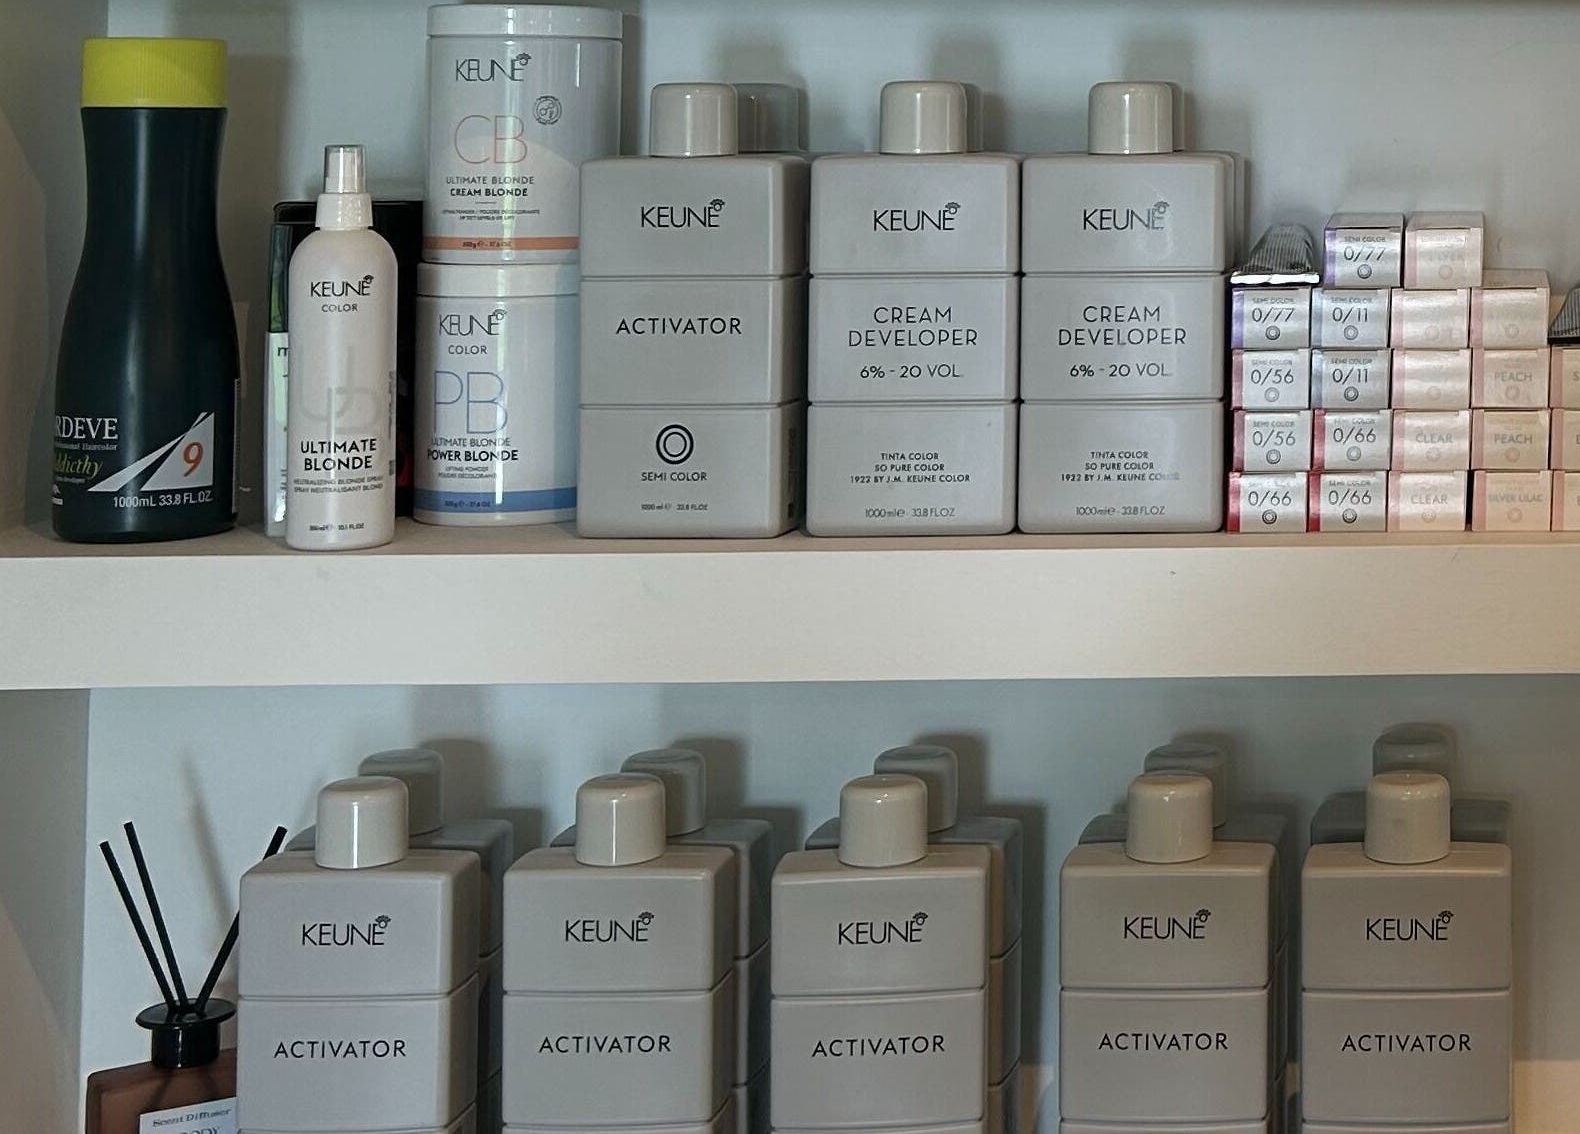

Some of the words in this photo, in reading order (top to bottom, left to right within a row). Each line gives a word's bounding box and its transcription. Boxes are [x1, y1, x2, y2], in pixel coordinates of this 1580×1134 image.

[456, 53, 532, 82] KEUNE
[455, 115, 527, 164] CB
[446, 176, 487, 185] ULTIMATE
[492, 176, 534, 185] BLONDE
[450, 188, 481, 197] CREAM
[485, 188, 528, 197] BLONDE
[640, 199, 725, 227] KEUNE
[873, 202, 961, 231] KEUNE
[1343, 246, 1384, 262] 0/77
[311, 275, 374, 297] KEUNE
[322, 304, 358, 313] COLOR
[874, 307, 952, 324] CREAM
[440, 309, 507, 336] KEUNE
[616, 318, 741, 335] ACTIVATOR
[848, 329, 978, 347] DEVELOPER
[448, 345, 487, 355] COLOR
[860, 365, 885, 378] 6%
[900, 365, 921, 378] 20
[1494, 371, 1532, 383] PEACH
[434, 370, 508, 434] PB
[301, 439, 376, 454] ULTIMATE
[431, 438, 467, 447] ULTIMATE
[470, 438, 511, 447] BLONDE
[183, 442, 203, 477] 9
[304, 455, 372, 471] BLONDE
[428, 449, 461, 461] POWER
[464, 450, 519, 461] BLONDE
[641, 472, 666, 481] SEMI
[671, 472, 707, 481] COLOR
[875, 464, 887, 472] SO
[907, 475, 936, 483] KEUNE
[939, 474, 970, 482] COLOR
[114, 496, 156, 508] 1000mL
[159, 495, 181, 506] 33.8
[301, 915, 391, 947] KEUNE
[837, 912, 928, 947] KEUNE
[1365, 911, 1453, 943] KEUNE
[274, 1040, 407, 1060] ACTIVATOR
[812, 1035, 945, 1059] ACTIVATOR
[1341, 1034, 1471, 1054] ACTIVATOR
